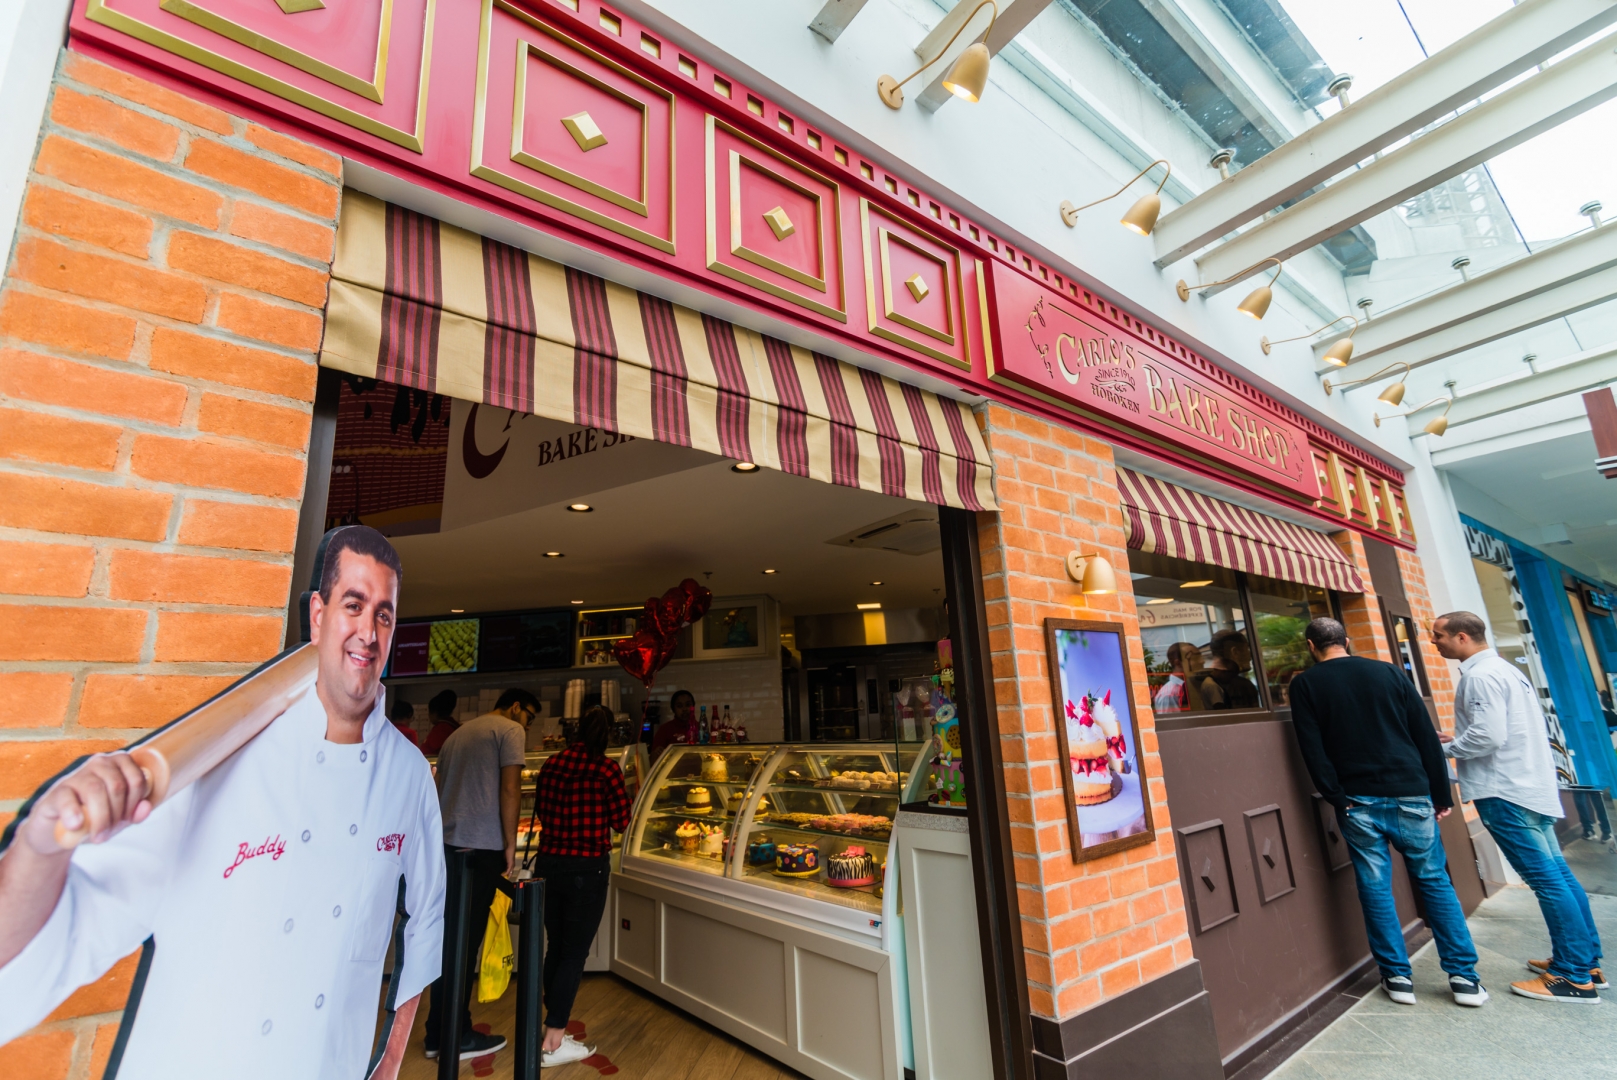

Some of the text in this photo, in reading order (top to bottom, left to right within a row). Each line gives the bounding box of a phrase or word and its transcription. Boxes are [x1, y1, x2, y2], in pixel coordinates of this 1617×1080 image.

[1055, 332, 1136, 384] CARLO'S
[1098, 367, 1136, 386] SINCE 1910
[1091, 383, 1140, 414] HOBOKEN
[1143, 364, 1289, 469] BAKE SHOP
[537, 427, 598, 467] BAKE
[223, 834, 286, 878] Buddy
